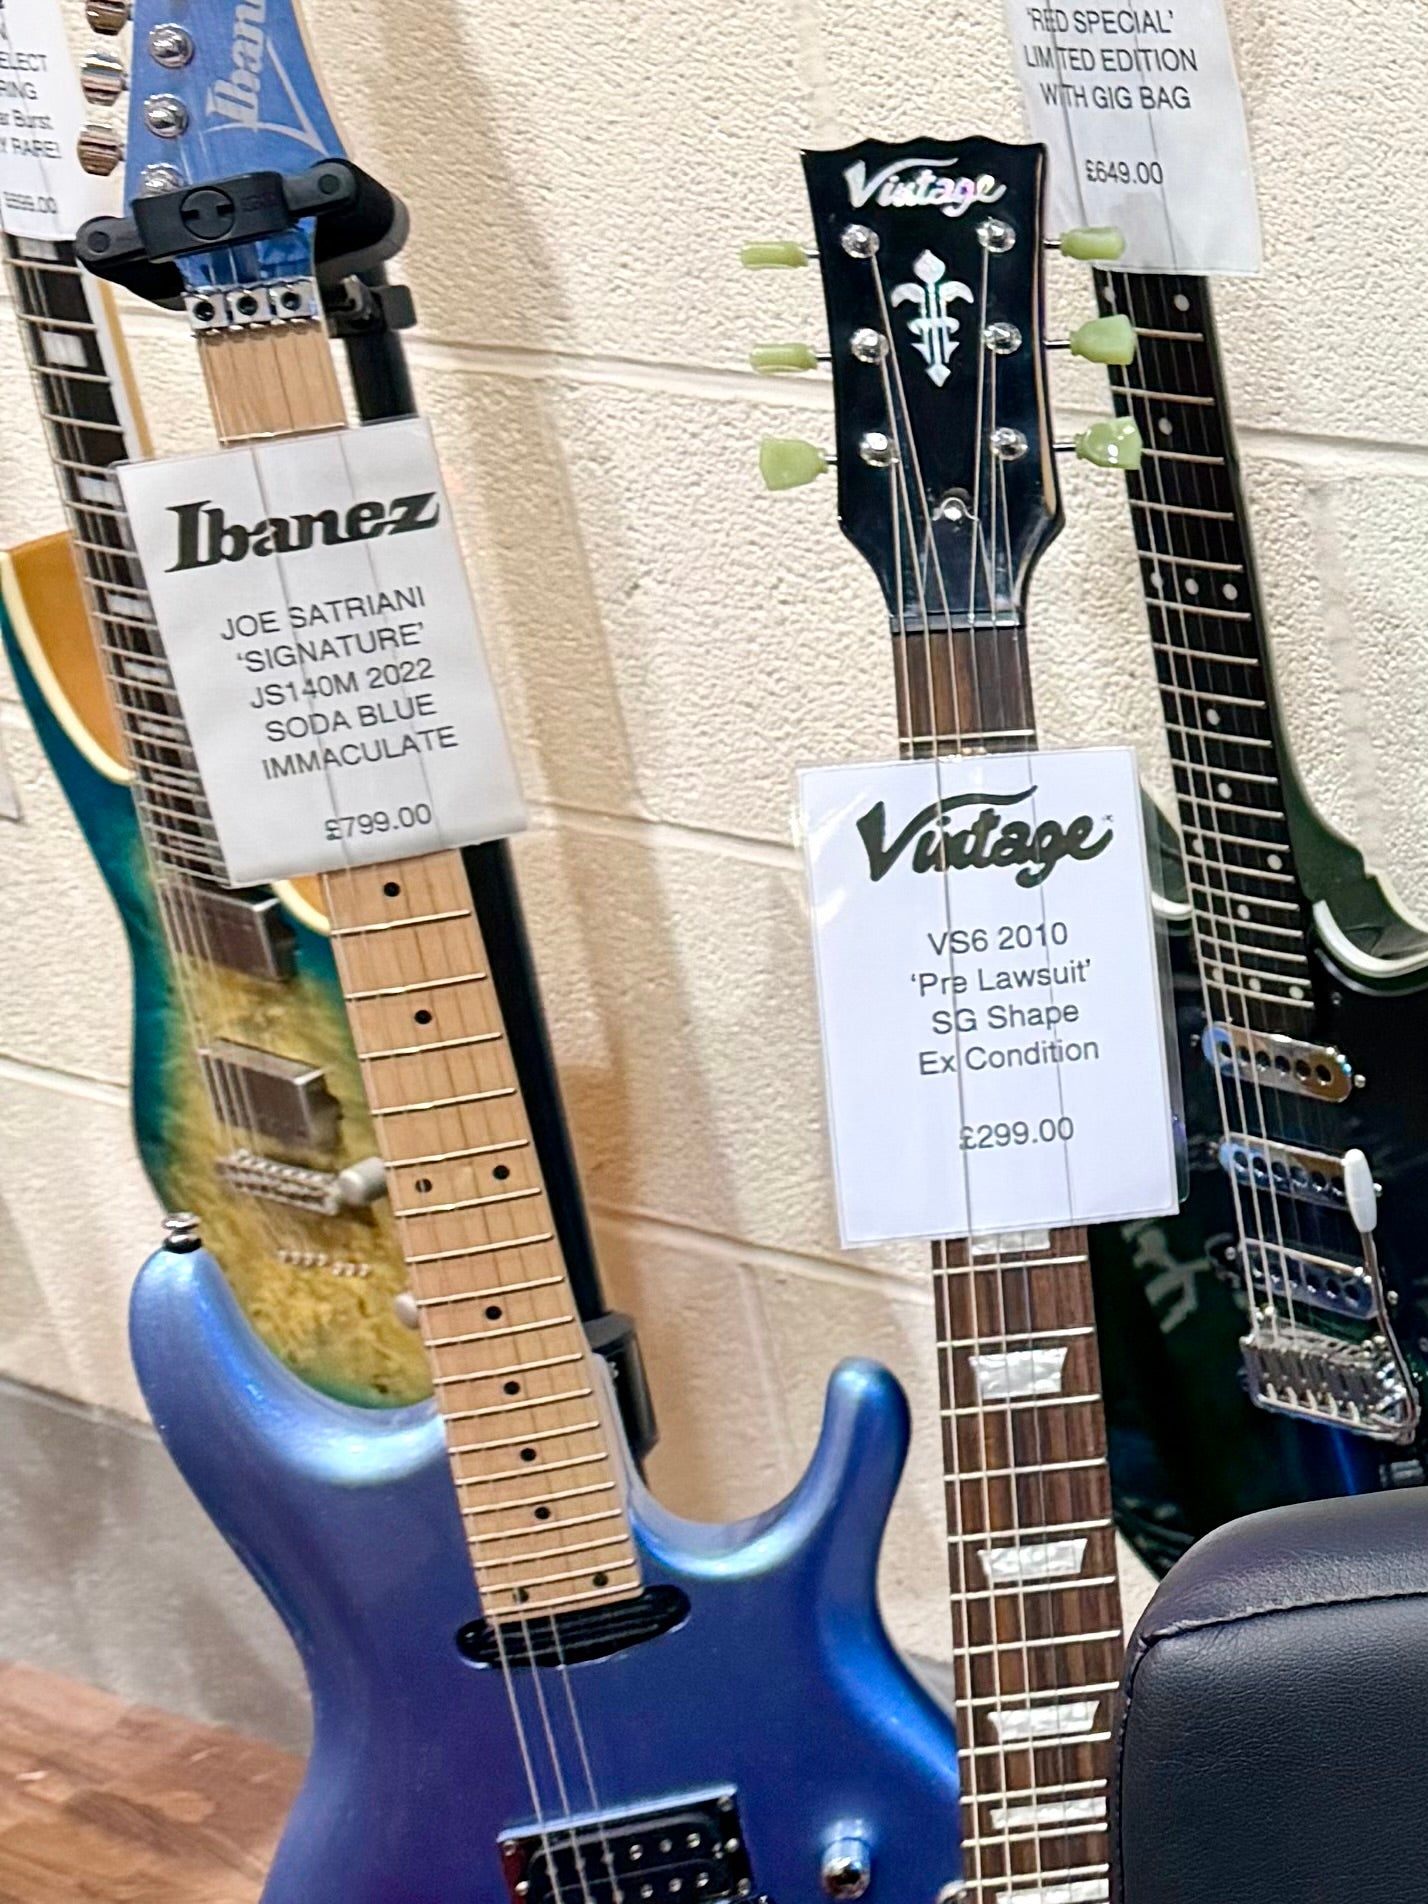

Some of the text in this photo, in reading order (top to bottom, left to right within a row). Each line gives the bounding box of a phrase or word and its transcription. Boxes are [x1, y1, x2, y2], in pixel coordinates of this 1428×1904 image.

[1102, 47, 1198, 72] EDITION
[1092, 84, 1132, 109] GIG
[1140, 86, 1192, 110] BAG
[842, 157, 1008, 218] Vintage
[1086, 160, 1164, 185] £649.00
[163, 491, 440, 574] Ibanez
[220, 585, 427, 641] JOE SATRIANI
[250, 657, 436, 710] JS140M 2022
[263, 693, 439, 743] SODA BLUE
[261, 724, 460, 781] IMMACULATE
[323, 802, 433, 842] £799.00
[855, 784, 1114, 889] Vintage
[926, 921, 1068, 956] VS6 2010
[931, 1002, 1080, 1036] SG Shape
[918, 1039, 1100, 1076] Ex Condition
[959, 1116, 1075, 1152] £299.00
